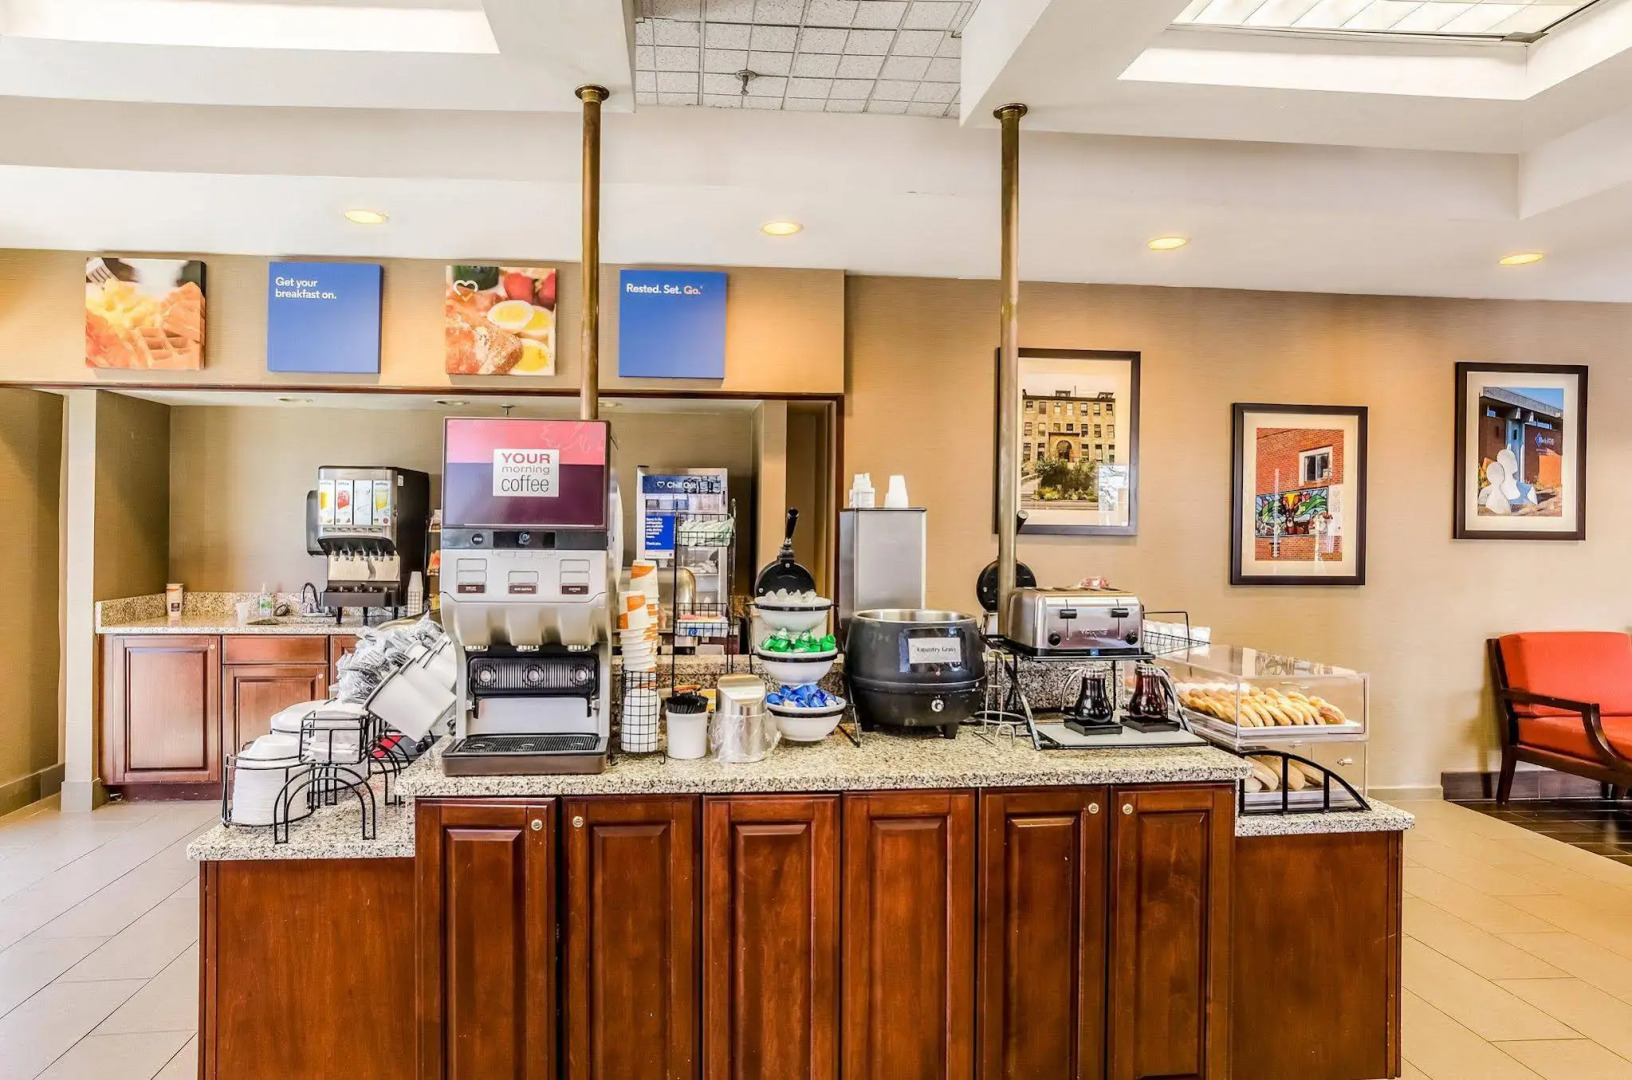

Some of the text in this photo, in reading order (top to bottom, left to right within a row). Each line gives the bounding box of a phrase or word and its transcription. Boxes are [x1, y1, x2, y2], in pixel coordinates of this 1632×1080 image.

[275, 276, 318, 288] Get your
[275, 288, 320, 299] breakfast
[626, 283, 662, 294] Rested.
[663, 284, 682, 295] Set.
[501, 452, 551, 464] YOUR
[501, 465, 550, 476] morning
[501, 474, 550, 493] coffee
